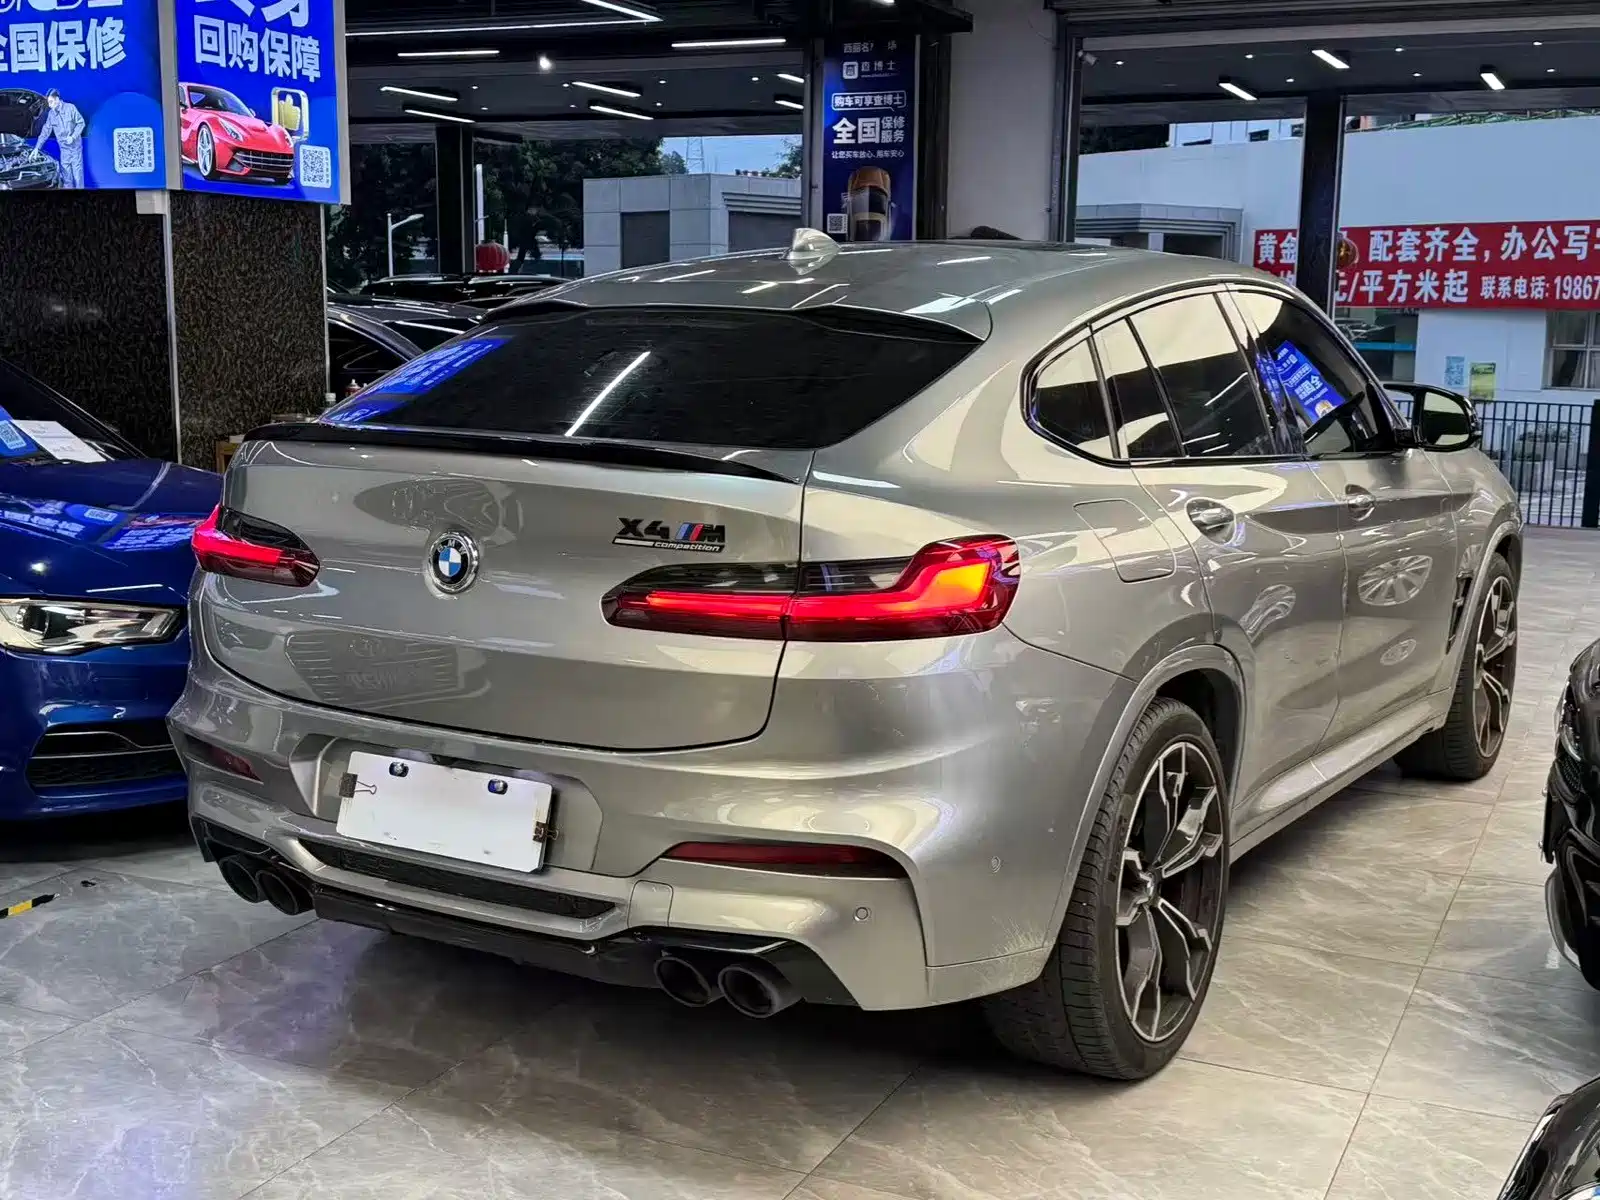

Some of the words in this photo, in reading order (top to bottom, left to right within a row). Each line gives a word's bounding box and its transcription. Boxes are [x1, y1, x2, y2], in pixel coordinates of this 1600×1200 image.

[0, 17, 126, 73] 国保修
[194, 15, 321, 82] 回购保障
[834, 93, 903, 107] 购车可享查博士
[832, 117, 880, 144] 全国
[881, 116, 905, 129] 保修
[881, 130, 905, 143] 服务
[1369, 225, 1600, 263] 配套齐全，办公写
[617, 517, 670, 539] X4
[654, 541, 720, 552] competition
